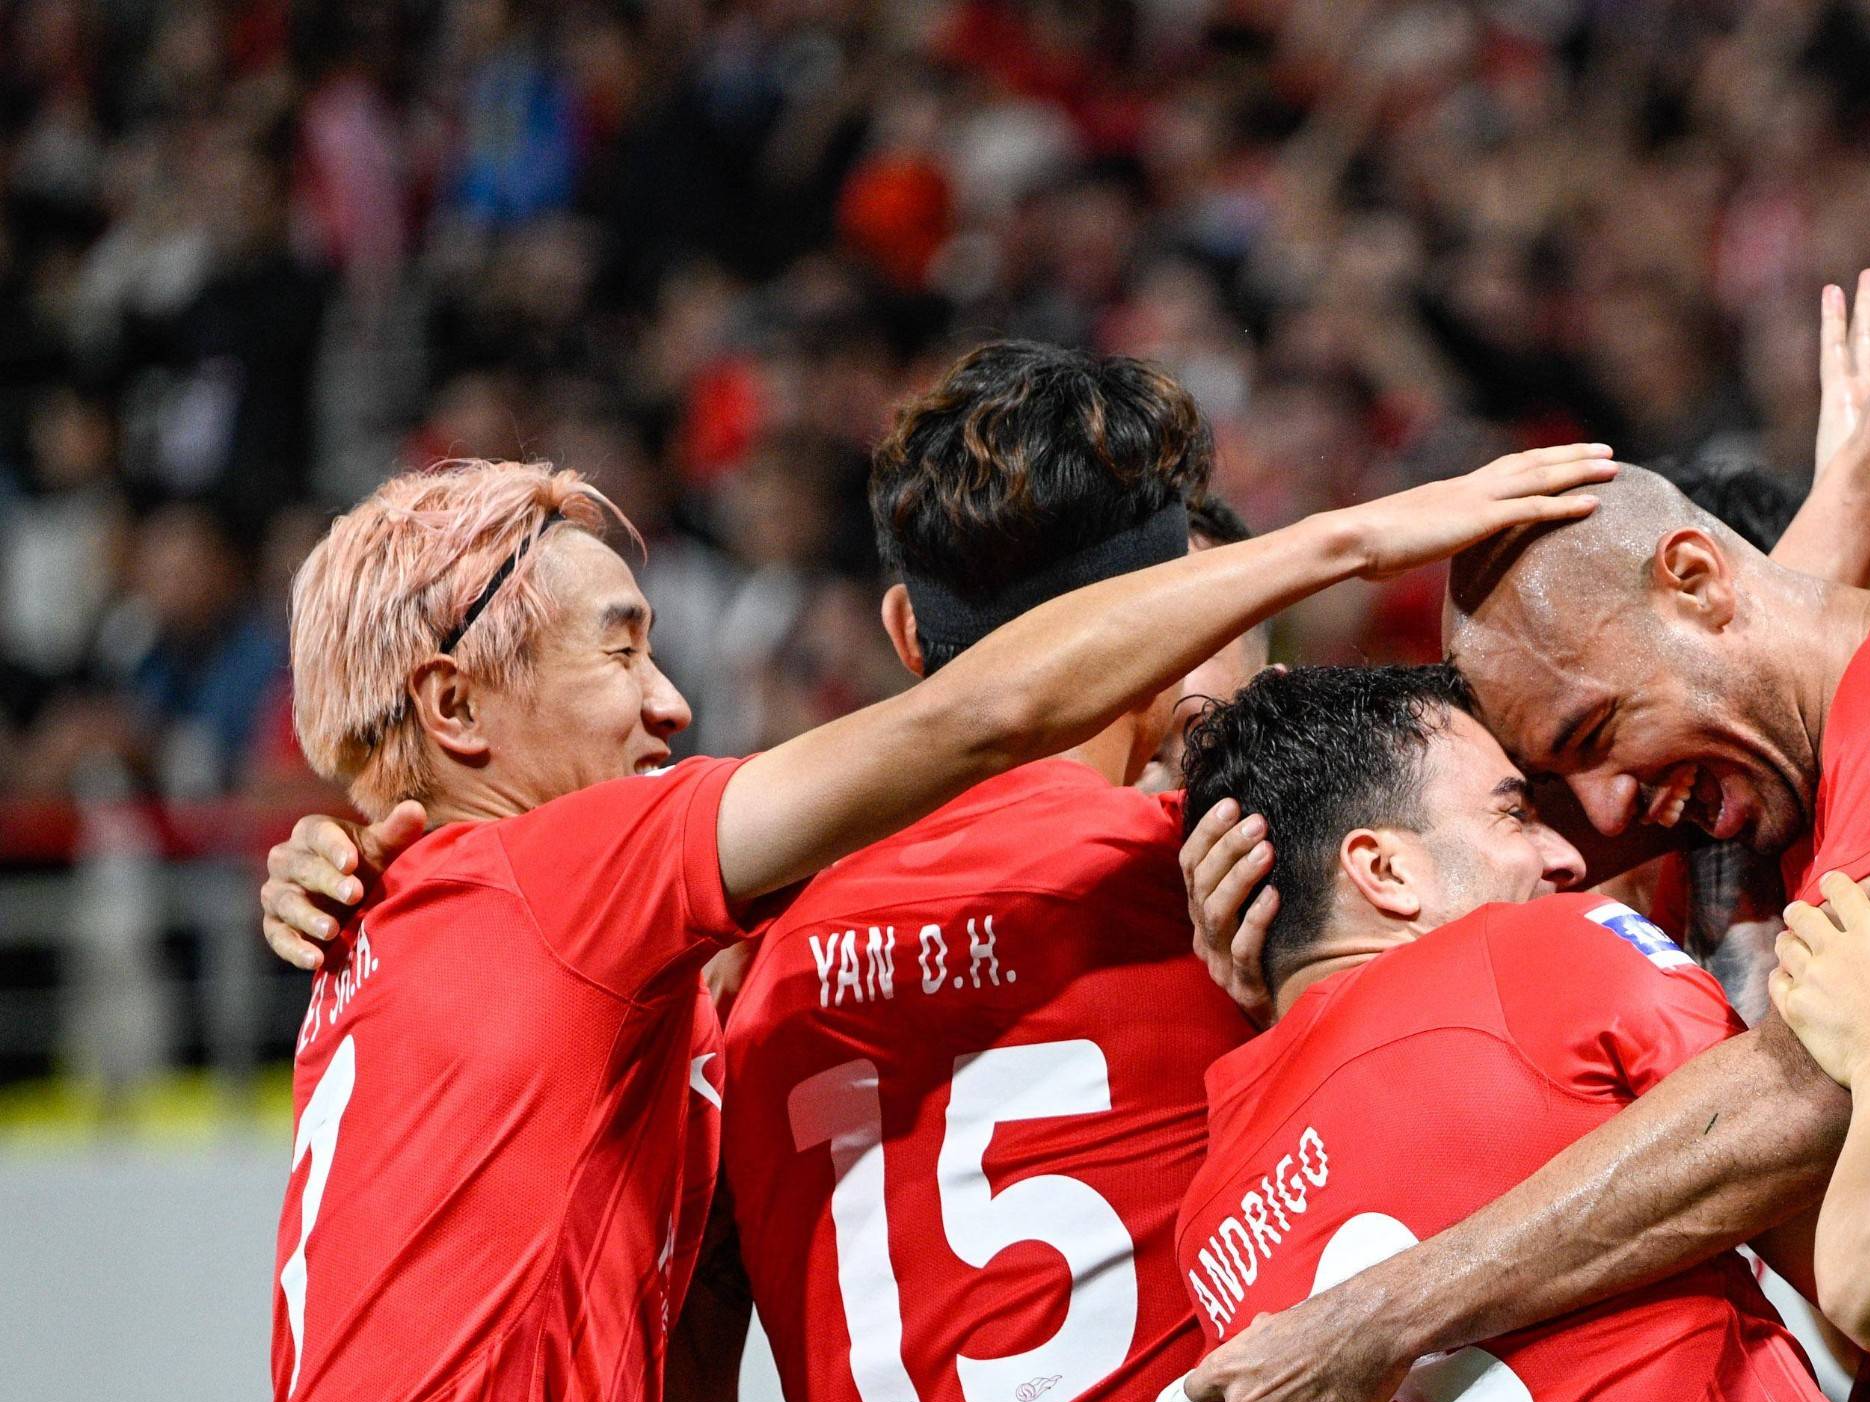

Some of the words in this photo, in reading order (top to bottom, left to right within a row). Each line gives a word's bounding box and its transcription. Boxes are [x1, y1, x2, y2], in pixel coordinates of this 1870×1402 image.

[808, 925, 896, 1008] YAN
[918, 914, 1017, 995] D.H.
[1188, 1126, 1329, 1340] ANDRIGO
